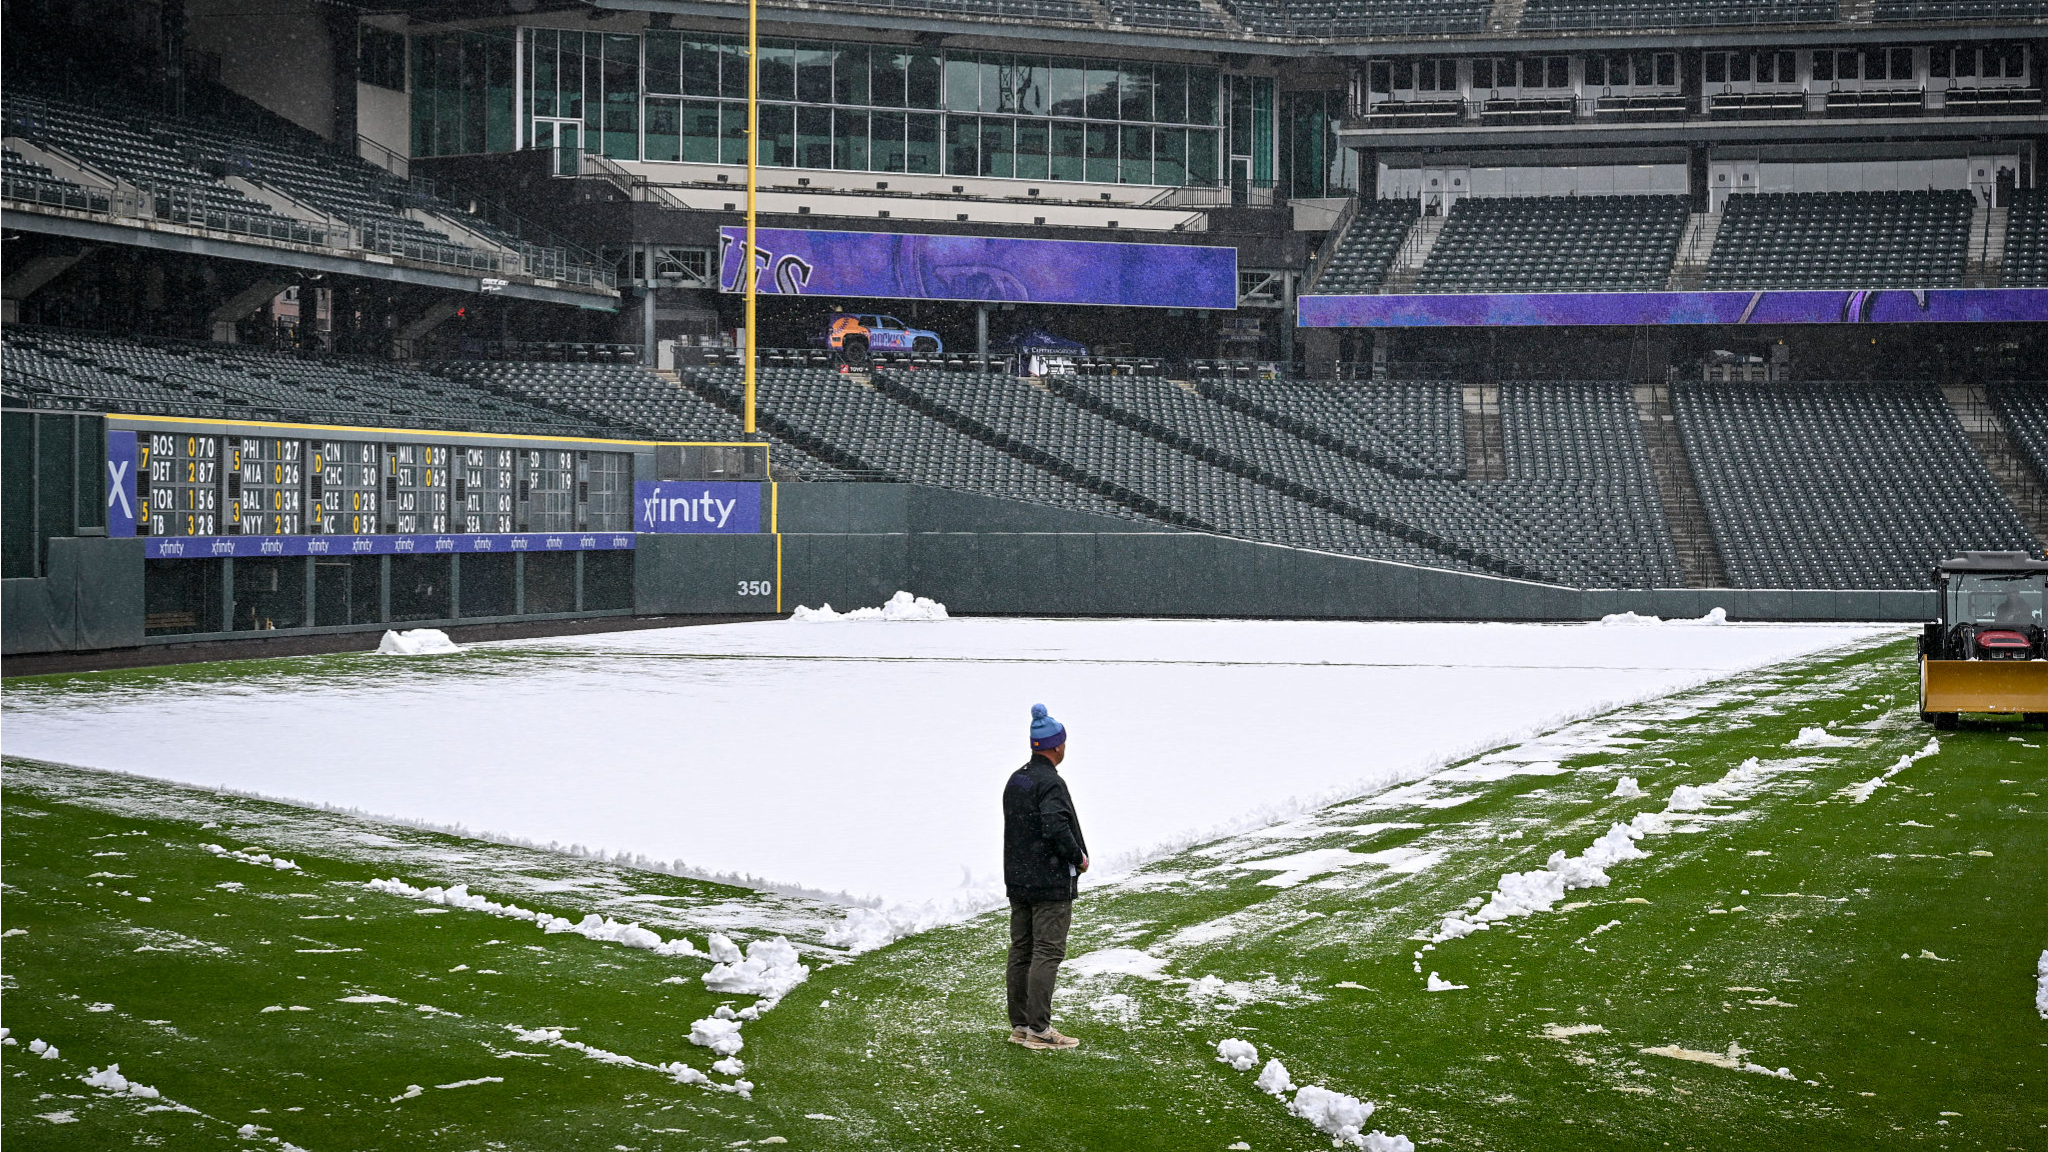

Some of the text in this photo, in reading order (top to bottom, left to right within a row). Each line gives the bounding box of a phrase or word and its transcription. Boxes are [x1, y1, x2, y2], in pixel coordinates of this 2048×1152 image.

[153, 435, 215, 458] BOS 0 70
[243, 440, 299, 460] PHI 1 27
[324, 443, 376, 463] CIN 61
[399, 446, 447, 465] MIL 0 39
[142, 447, 150, 468] 7
[234, 450, 240, 471] 5
[467, 449, 511, 468] CWS 65
[530, 451, 572, 469] SD 98
[153, 461, 215, 482] DET 2 87
[243, 464, 299, 484] MIA 0 26
[324, 466, 376, 486] CHC 30
[399, 468, 446, 487] STL 0 62
[467, 470, 511, 489] LAA 59
[530, 472, 572, 490] SF 19
[153, 489, 214, 510] TOR 1 56
[243, 490, 299, 510] BAL 0 34
[324, 491, 376, 511] CLE 0 28
[398, 493, 446, 511] LAD 18
[467, 494, 511, 512] ATL 60
[644, 488, 737, 528] xfinity
[142, 501, 149, 522] 5
[233, 502, 240, 522] 3
[315, 503, 322, 523] 2
[153, 515, 214, 535] TB 3 28
[242, 515, 298, 534] NYY 2 31
[324, 515, 376, 534] KC 0 52
[398, 515, 446, 533] HOU 48
[466, 515, 511, 533] SEA 36
[737, 581, 771, 595] 350
